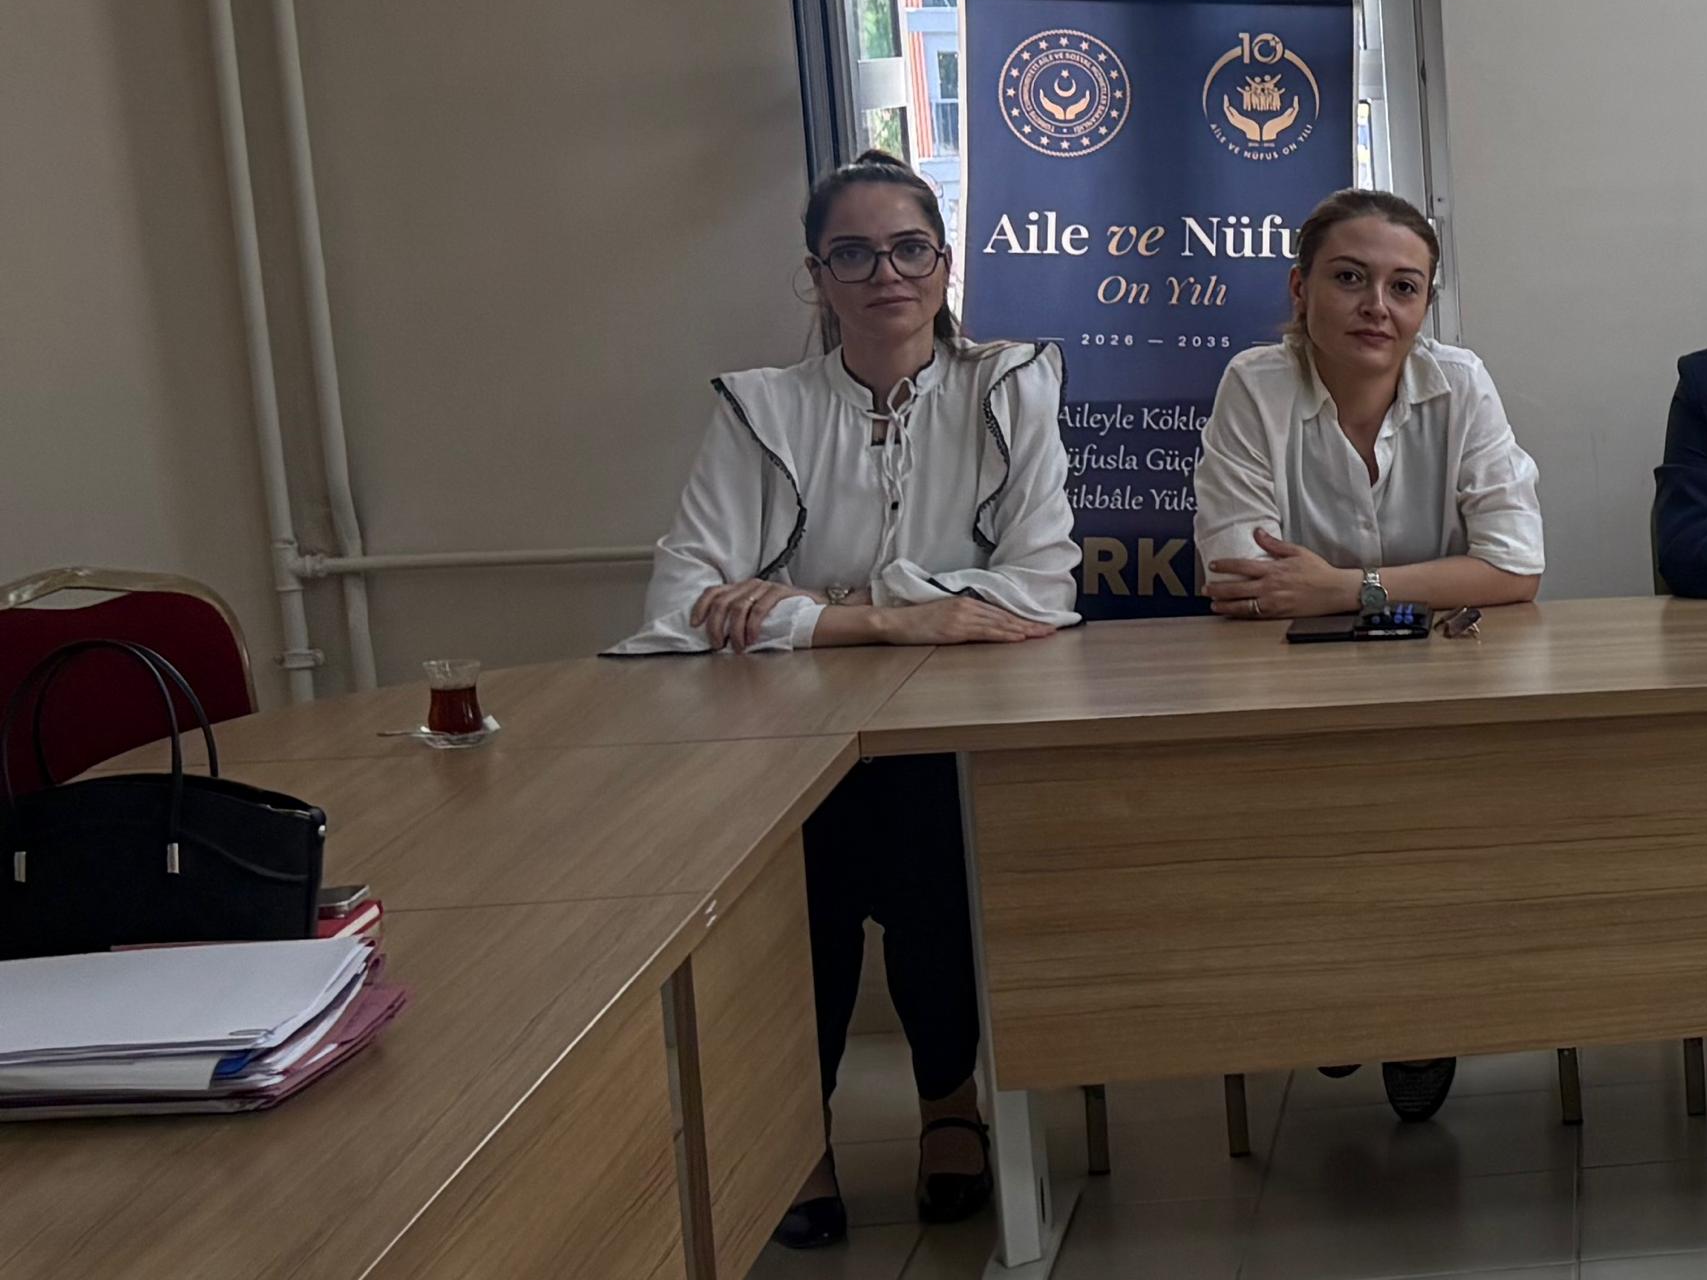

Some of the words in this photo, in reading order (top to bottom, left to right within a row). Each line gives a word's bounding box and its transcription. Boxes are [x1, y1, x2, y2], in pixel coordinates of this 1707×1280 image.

[982, 211, 1090, 255] Aile
[1106, 225, 1167, 257] ve
[1180, 214, 1301, 259] Nüfu
[1097, 275, 1150, 305] On
[1166, 275, 1228, 306] Yılı
[1081, 333, 1134, 346] 2026
[1178, 336, 1231, 348] 2035
[1059, 402, 1134, 436] Aileyle
[1142, 405, 1208, 431] Kökle
[1067, 443, 1139, 477] üfusla
[1065, 484, 1144, 510] tikbâle
